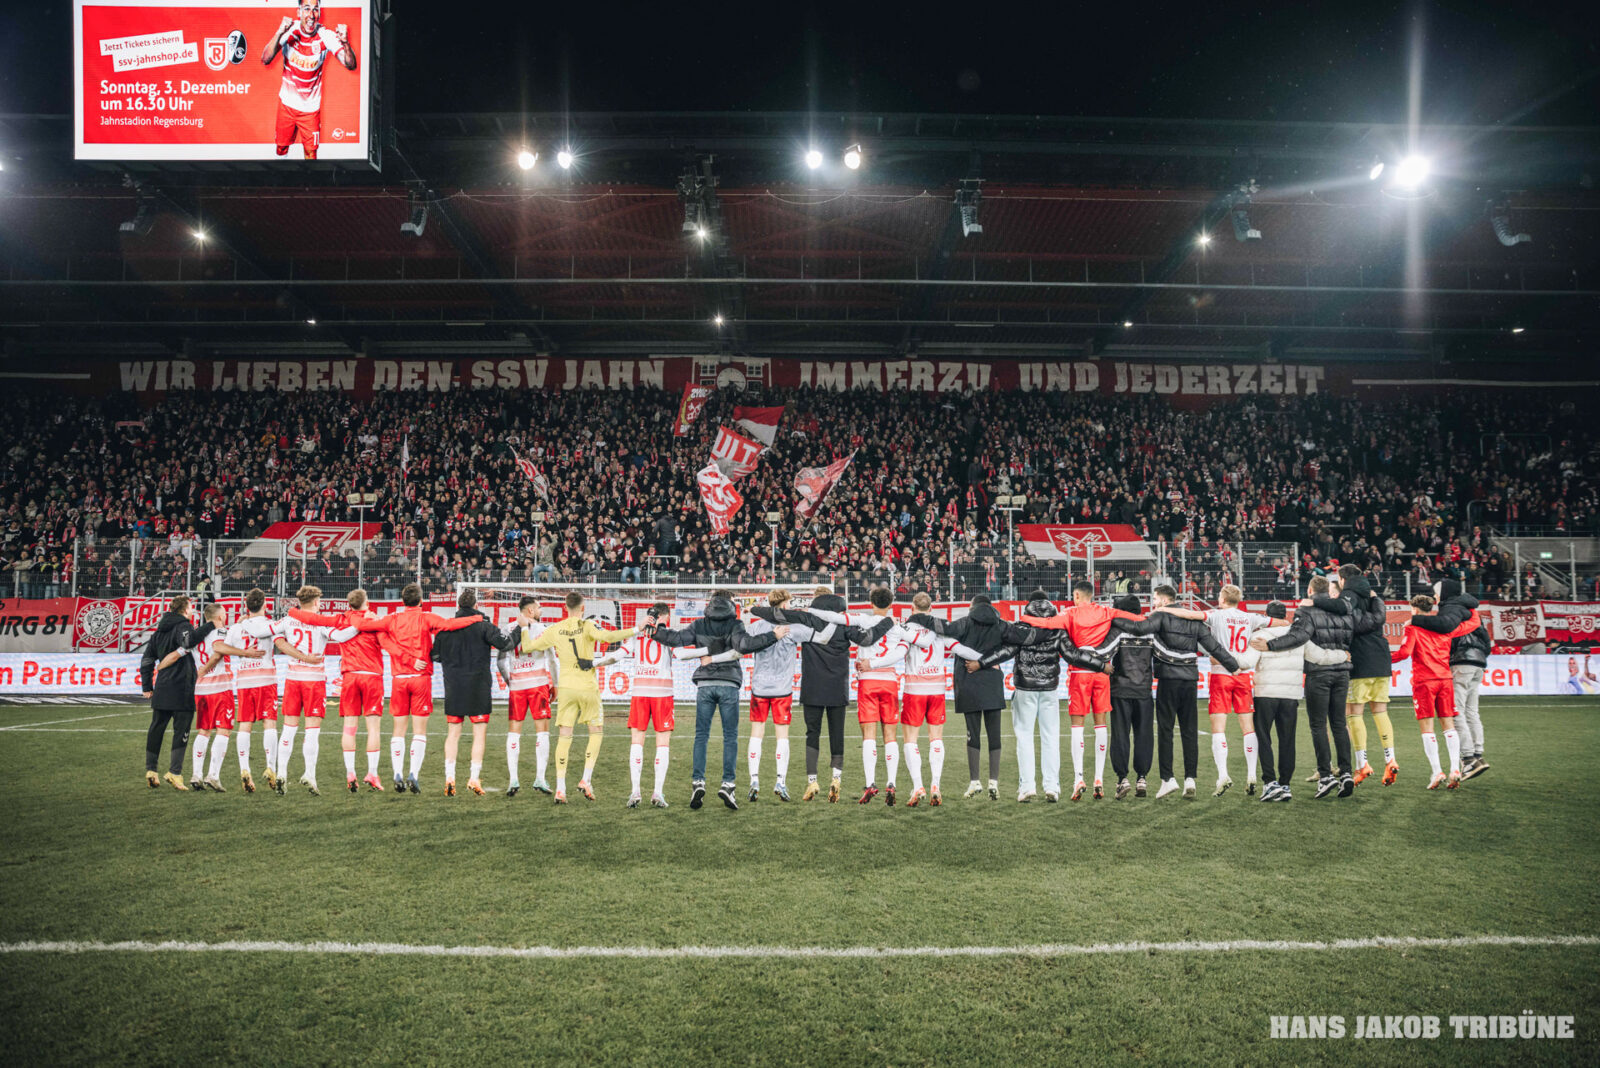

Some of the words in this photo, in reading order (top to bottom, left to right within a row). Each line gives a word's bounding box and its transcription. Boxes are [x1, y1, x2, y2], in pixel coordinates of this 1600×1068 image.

[104, 43, 123, 52] Jetzt
[124, 40, 151, 50] Tickets
[152, 36, 180, 47] sichern
[118, 48, 193, 67] ssv-jahnshop.de
[100, 80, 161, 97] Sonntag,
[164, 80, 178, 95] 3.
[181, 80, 251, 95] Dezember
[100, 98, 122, 111] um
[126, 97, 166, 111] 16.30
[169, 96, 194, 111] Uhr
[100, 116, 152, 126] Jahnstadion
[153, 116, 204, 129] Regensburg
[119, 361, 196, 391] WIR
[212, 361, 357, 392] LIEBEN
[372, 360, 453, 392] DEN
[471, 360, 550, 390] SSV
[563, 360, 665, 392] JAHN
[799, 361, 992, 393] IMMERZU
[1018, 362, 1099, 393] UND
[1114, 363, 1325, 395] JEDERZEIT
[332, 601, 351, 611] JAH
[42, 615, 69, 635] 81
[293, 628, 313, 654] 21
[1227, 625, 1248, 653] 16
[197, 640, 209, 665] 8
[637, 636, 662, 665] 10
[22, 660, 127, 686] Partner
